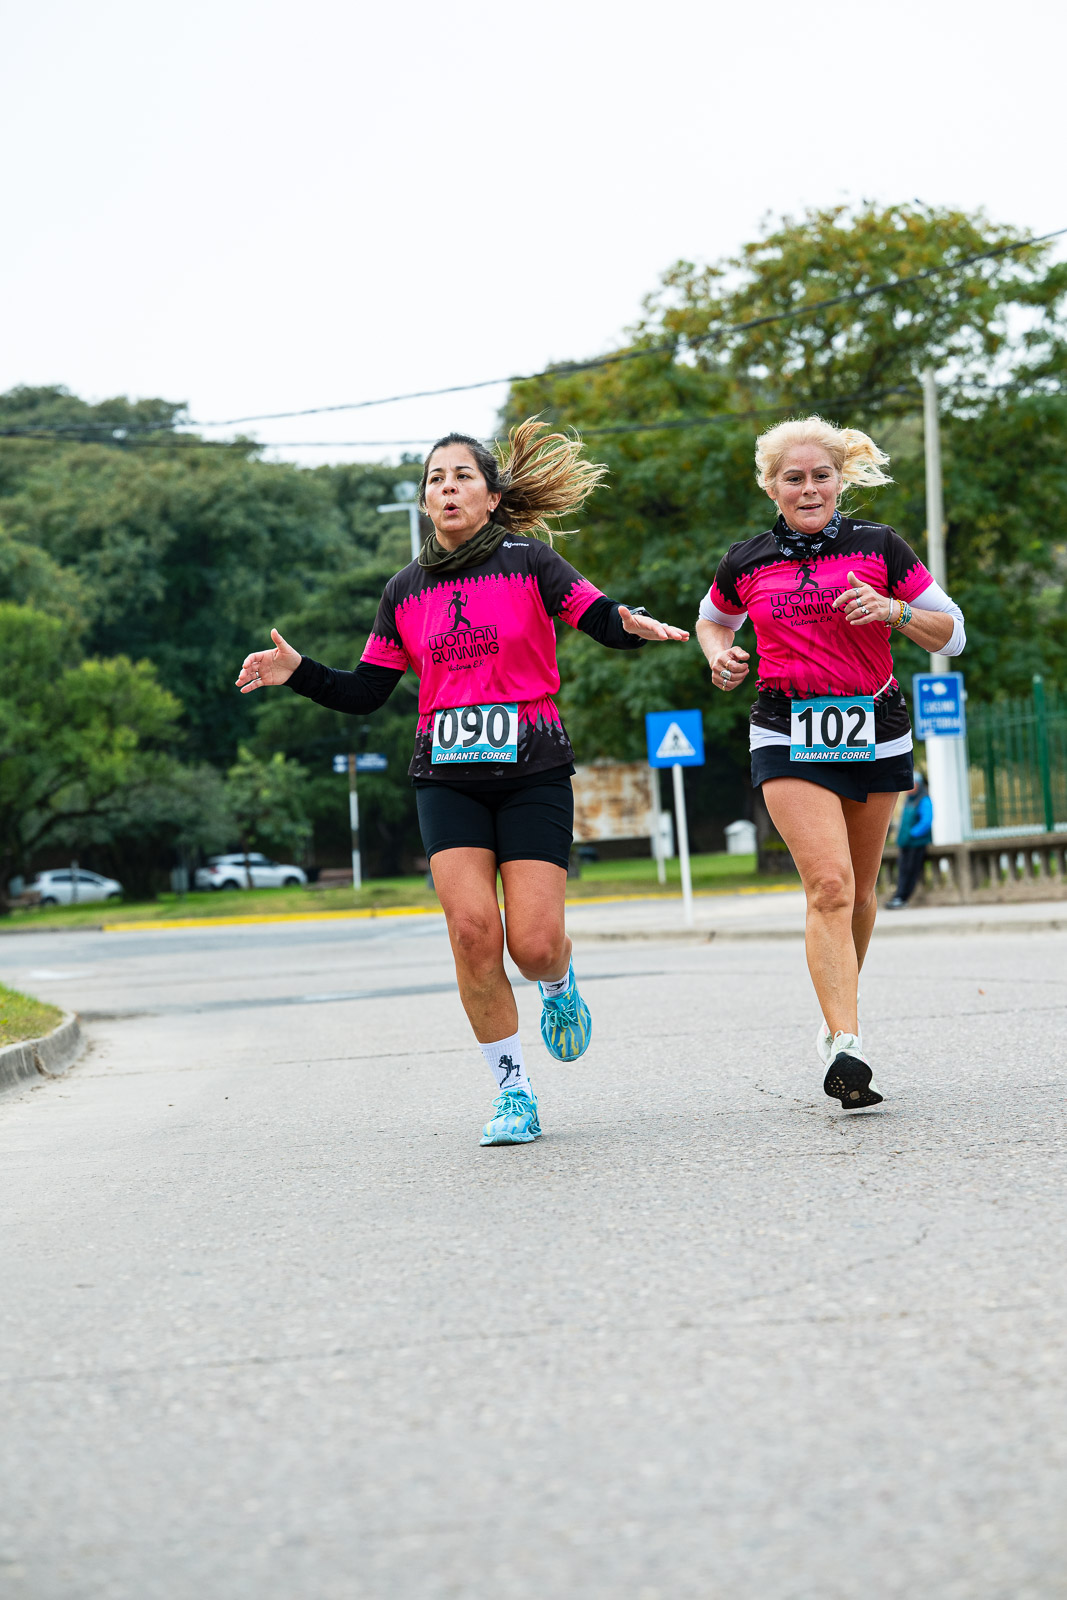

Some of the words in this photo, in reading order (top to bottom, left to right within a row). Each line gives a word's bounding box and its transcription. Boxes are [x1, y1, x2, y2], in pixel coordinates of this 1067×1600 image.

[428, 627, 498, 651] WOMAN
[431, 641, 499, 665] RUNNING
[438, 704, 510, 750] 090
[797, 705, 868, 749] 102
[435, 751, 480, 762] DIAMANTE
[481, 752, 513, 761] CORRE
[794, 752, 840, 760] DIAMANTE
[841, 751, 872, 760] CORRE
